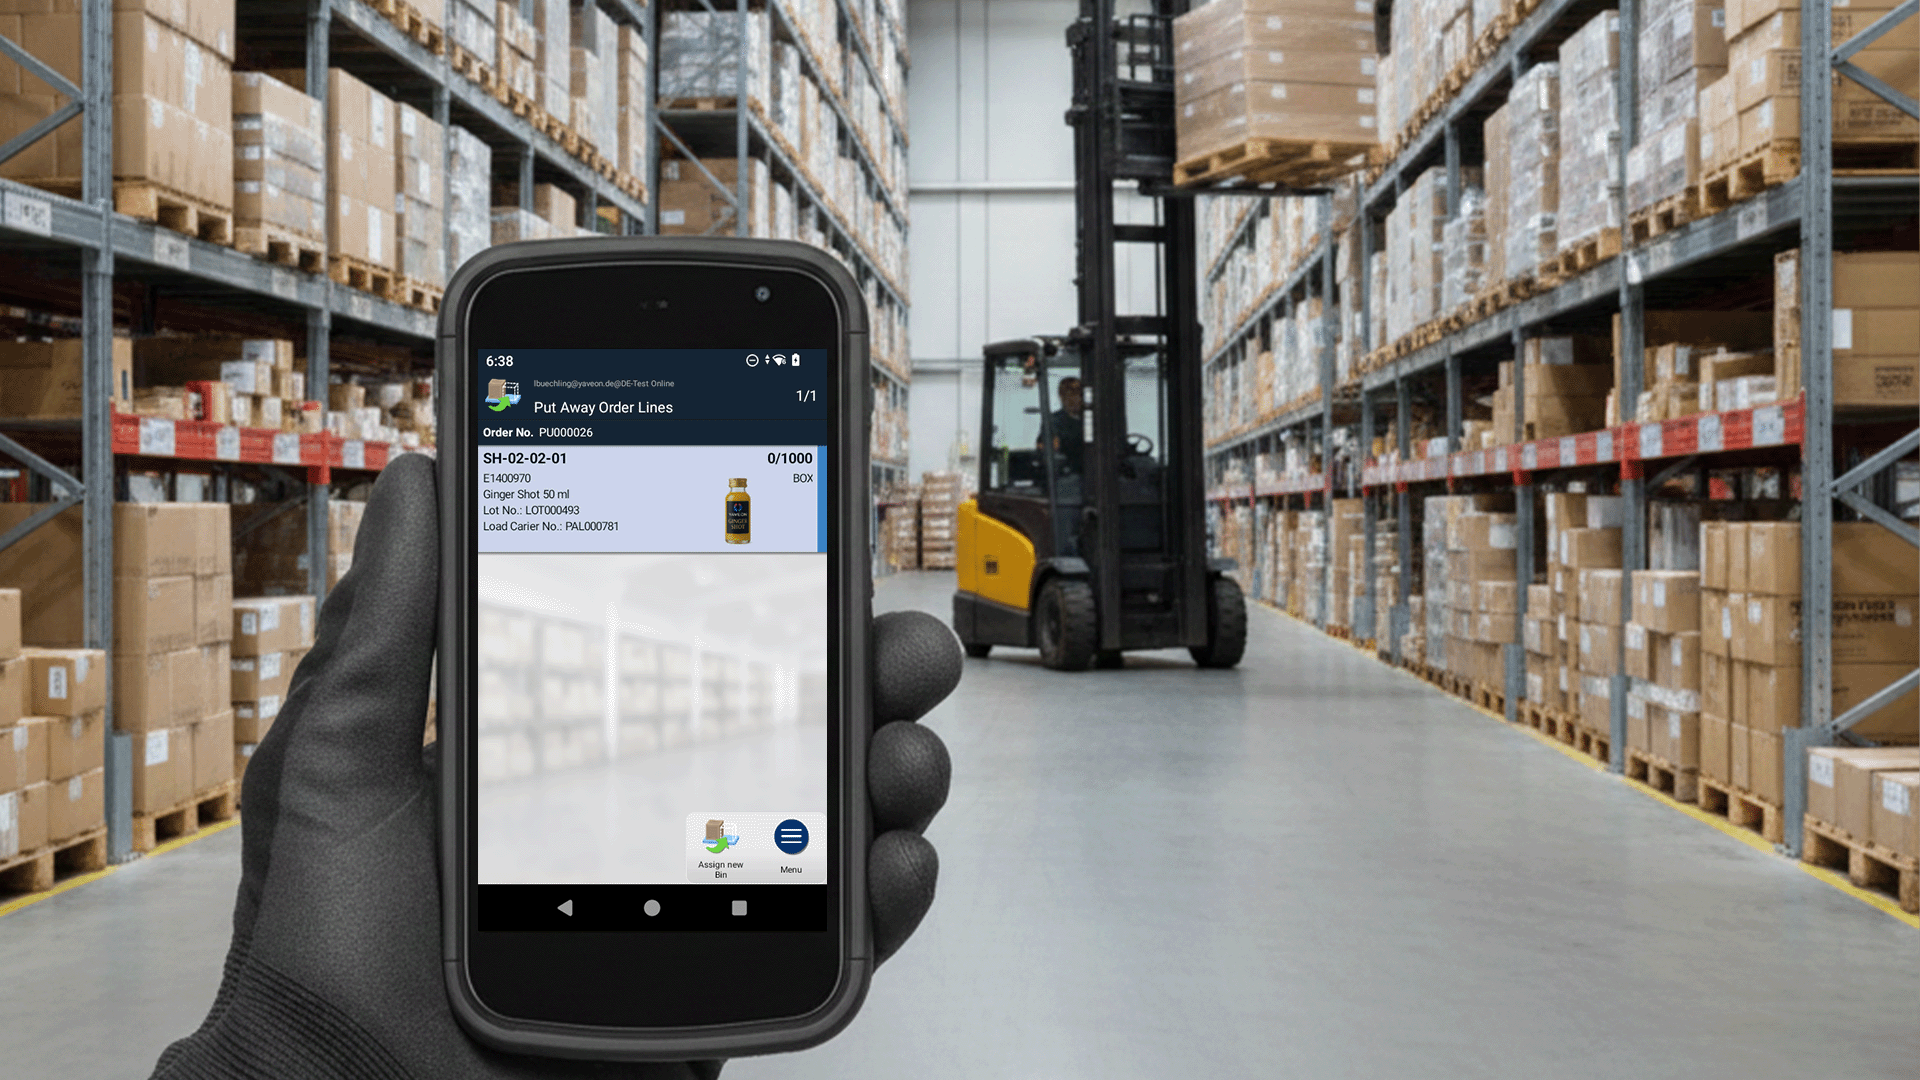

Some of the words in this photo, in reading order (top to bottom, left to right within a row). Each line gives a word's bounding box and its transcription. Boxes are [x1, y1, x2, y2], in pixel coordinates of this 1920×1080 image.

[487, 356, 514, 367] 6:38
[650, 380, 675, 388] Online
[796, 390, 816, 402] 1/1
[534, 402, 557, 414] Put
[560, 402, 596, 417] Away
[599, 401, 635, 414] Order
[638, 402, 674, 414] Lines
[483, 428, 514, 438] Order
[516, 428, 534, 438] No.
[539, 428, 594, 438] PU000026
[483, 453, 567, 464] SH-02-02-01
[767, 453, 813, 464] 0/1000
[483, 474, 532, 483] E1400970
[793, 474, 814, 483] BOX
[483, 489, 515, 501] Ginger
[517, 489, 540, 499] Shot
[543, 490, 556, 499] 50
[557, 489, 570, 499] ml
[483, 505, 500, 515] Lot
[502, 505, 523, 515] No.:
[525, 505, 580, 515] LOT000493
[483, 521, 508, 531] Load
[510, 521, 540, 531] Carier
[542, 521, 563, 531] No.:
[565, 521, 619, 531] PAL000781
[698, 861, 726, 870] Assign
[780, 866, 803, 874] Menu
[715, 871, 728, 879] Bin
